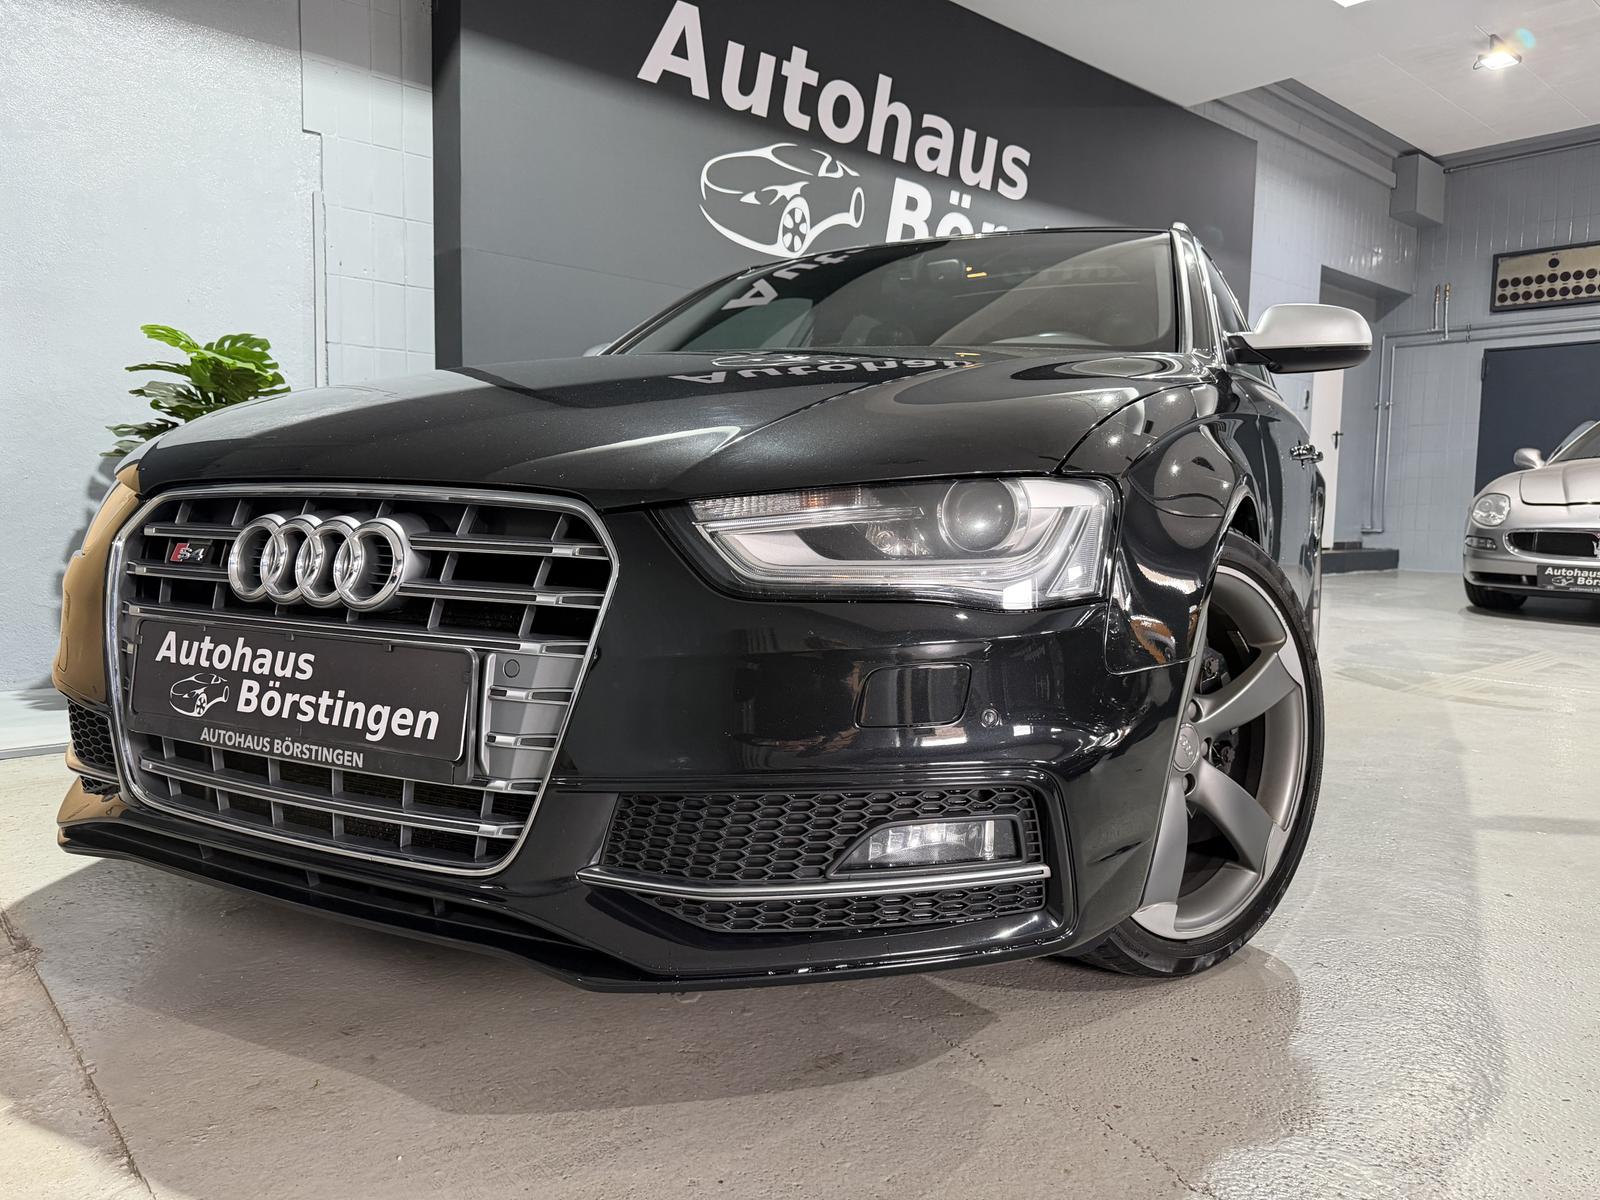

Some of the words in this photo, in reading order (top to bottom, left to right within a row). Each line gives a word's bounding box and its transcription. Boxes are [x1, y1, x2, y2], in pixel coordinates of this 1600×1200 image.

[637, 0, 1031, 200] Autohaus
[155, 630, 316, 681] Autohaus
[236, 679, 440, 742] Börstingen
[200, 726, 271, 753] AUTOHAUS
[273, 736, 364, 769] BÖRSTINGEN
